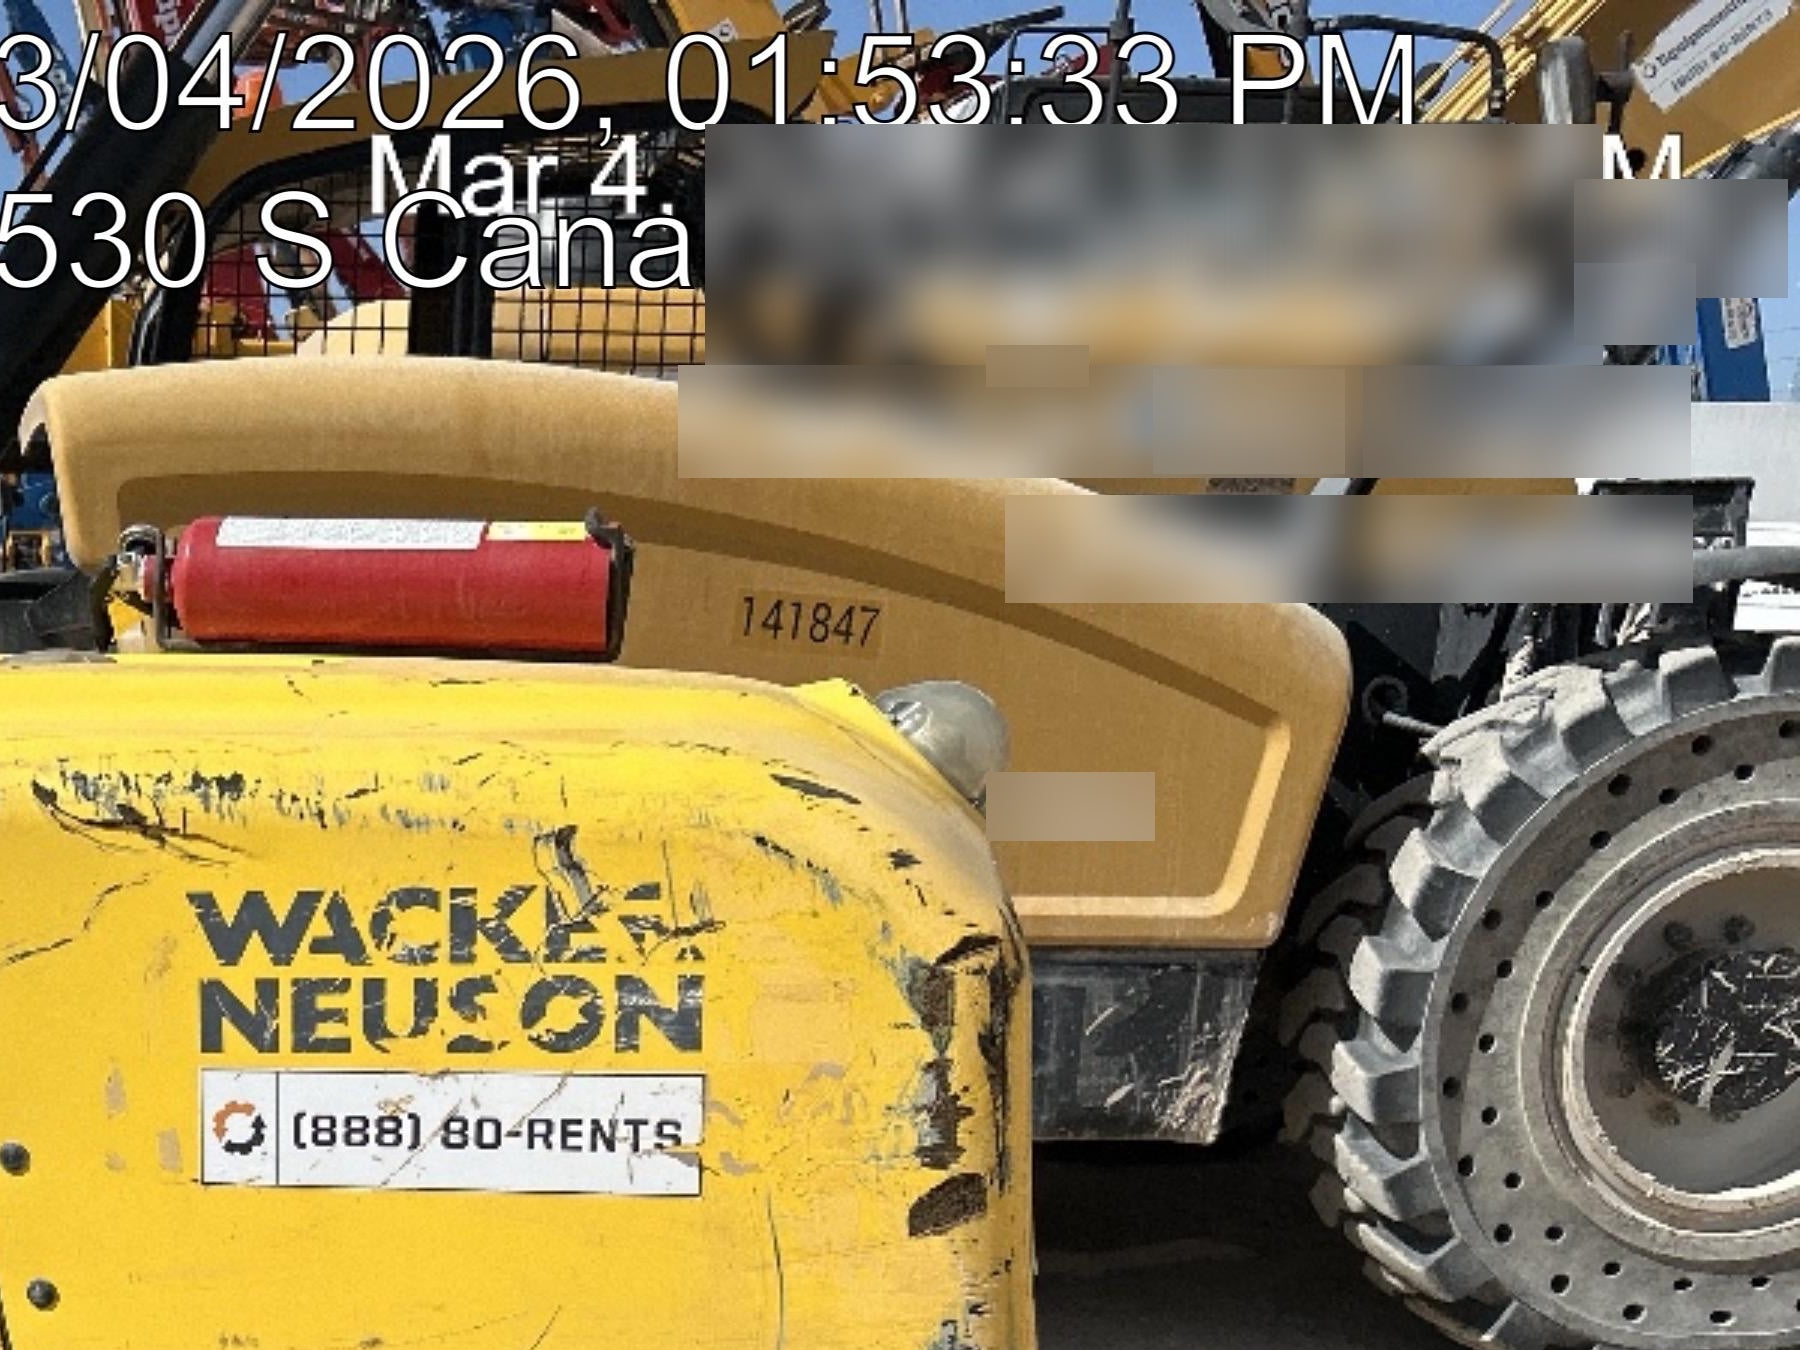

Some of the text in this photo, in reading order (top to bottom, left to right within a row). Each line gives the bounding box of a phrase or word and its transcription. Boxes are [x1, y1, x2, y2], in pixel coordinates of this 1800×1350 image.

[742, 596, 881, 649] 141847
[199, 973, 705, 1053] NEUSON
[292, 1112, 684, 1153] (888) 80-RENTS
